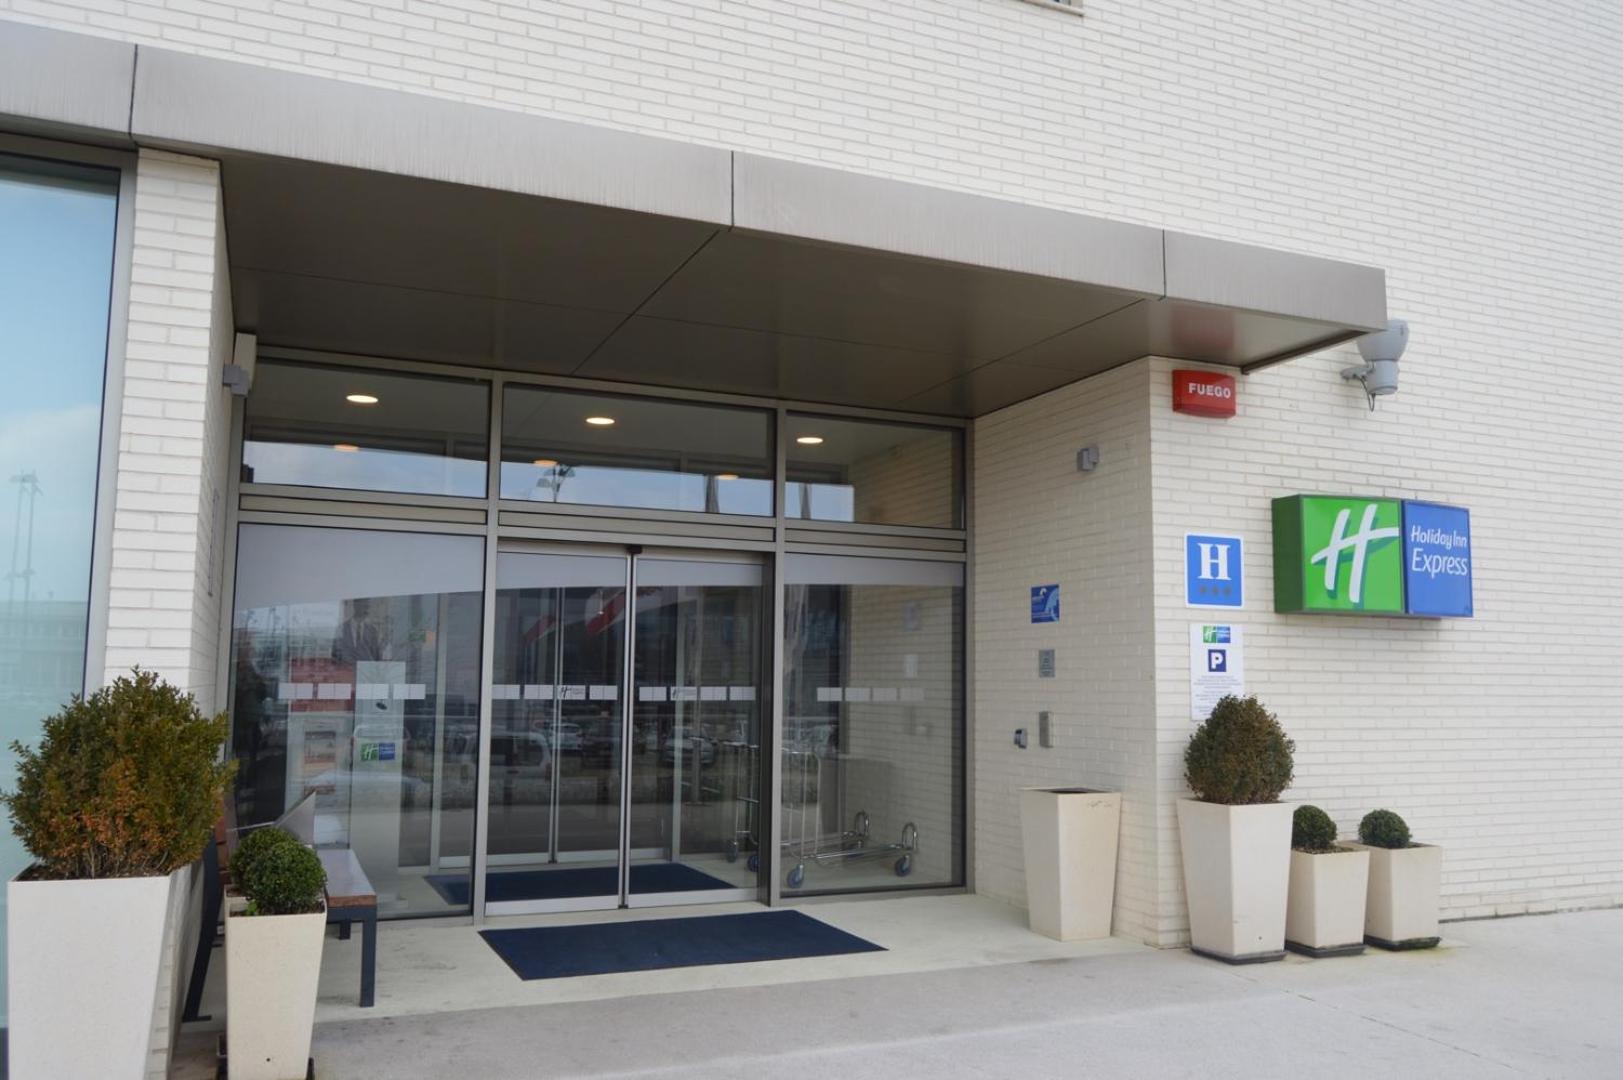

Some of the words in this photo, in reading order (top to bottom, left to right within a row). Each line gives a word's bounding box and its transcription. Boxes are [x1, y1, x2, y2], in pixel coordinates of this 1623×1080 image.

[1188, 382, 1232, 399] FUEGO
[1411, 524, 1453, 550] Holiday
[1453, 530, 1468, 548] Inn
[1198, 542, 1231, 581] H
[1411, 547, 1468, 579] Express
[1210, 652, 1224, 669] P
